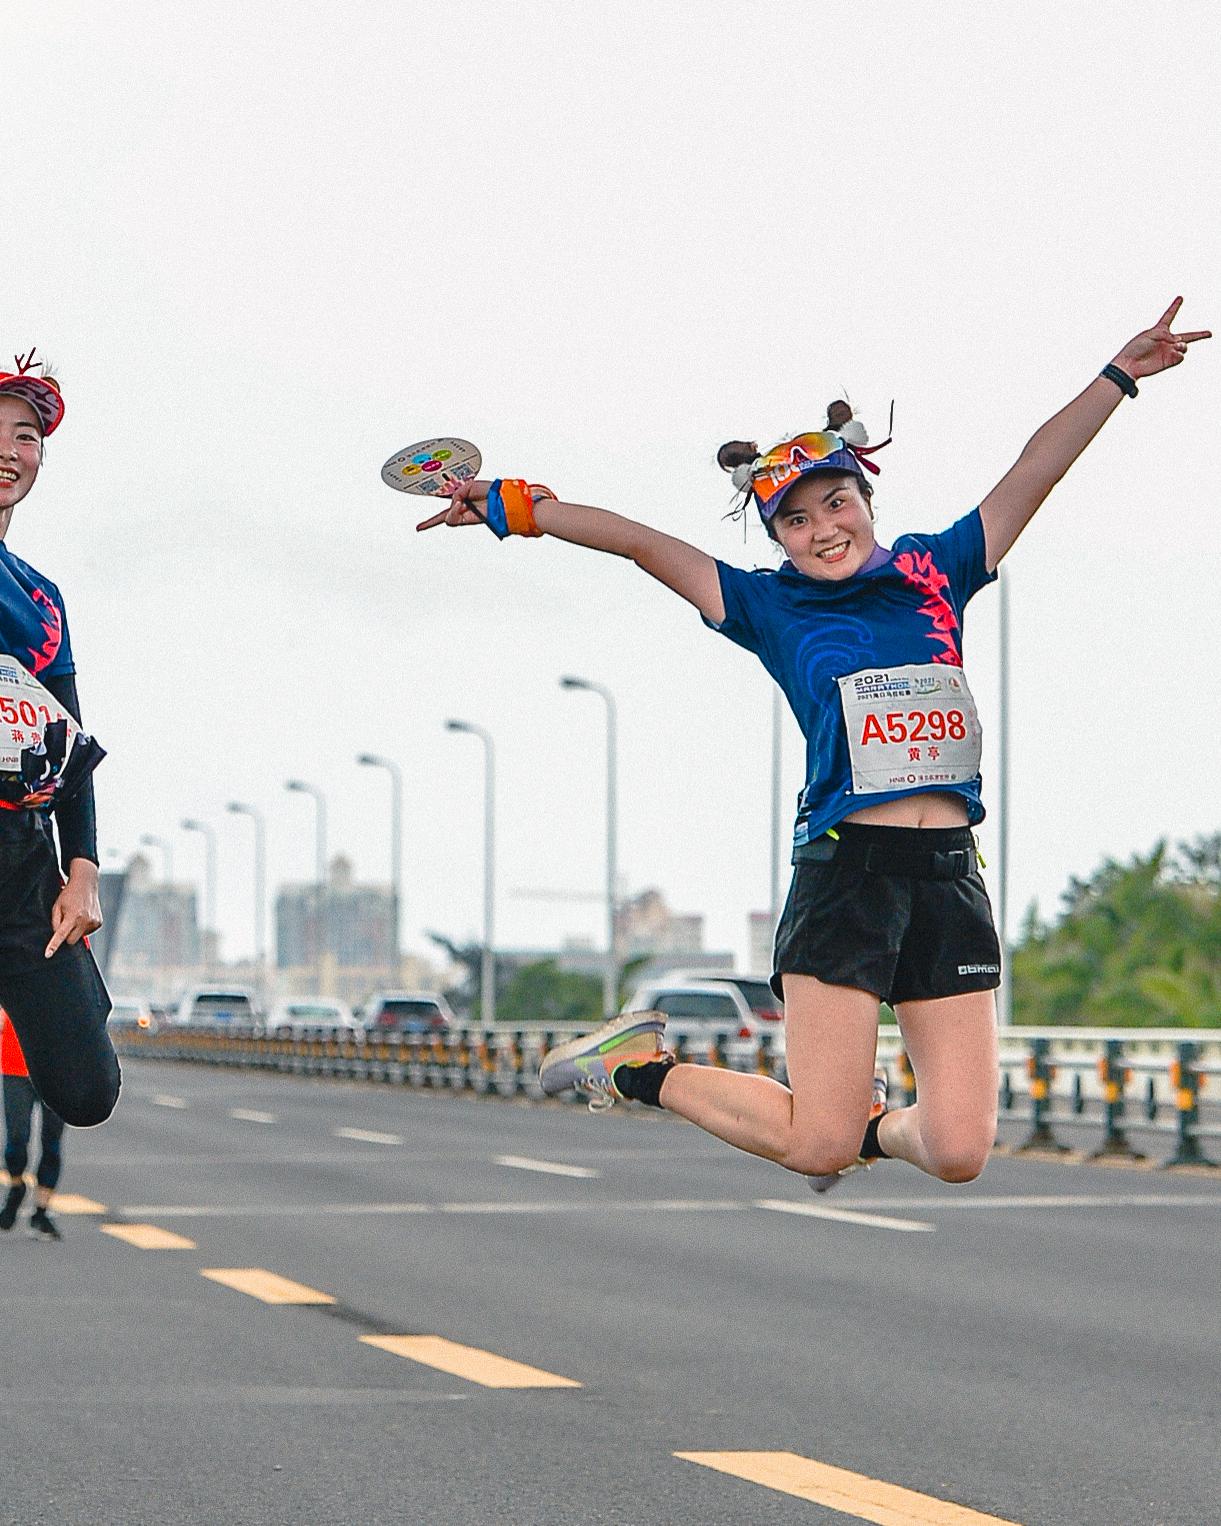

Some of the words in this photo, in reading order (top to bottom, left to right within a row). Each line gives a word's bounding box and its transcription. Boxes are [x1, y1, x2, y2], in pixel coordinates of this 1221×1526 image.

[854, 673, 889, 687] 2021
[856, 681, 910, 694] MARATHON
[861, 709, 966, 746] A5298
